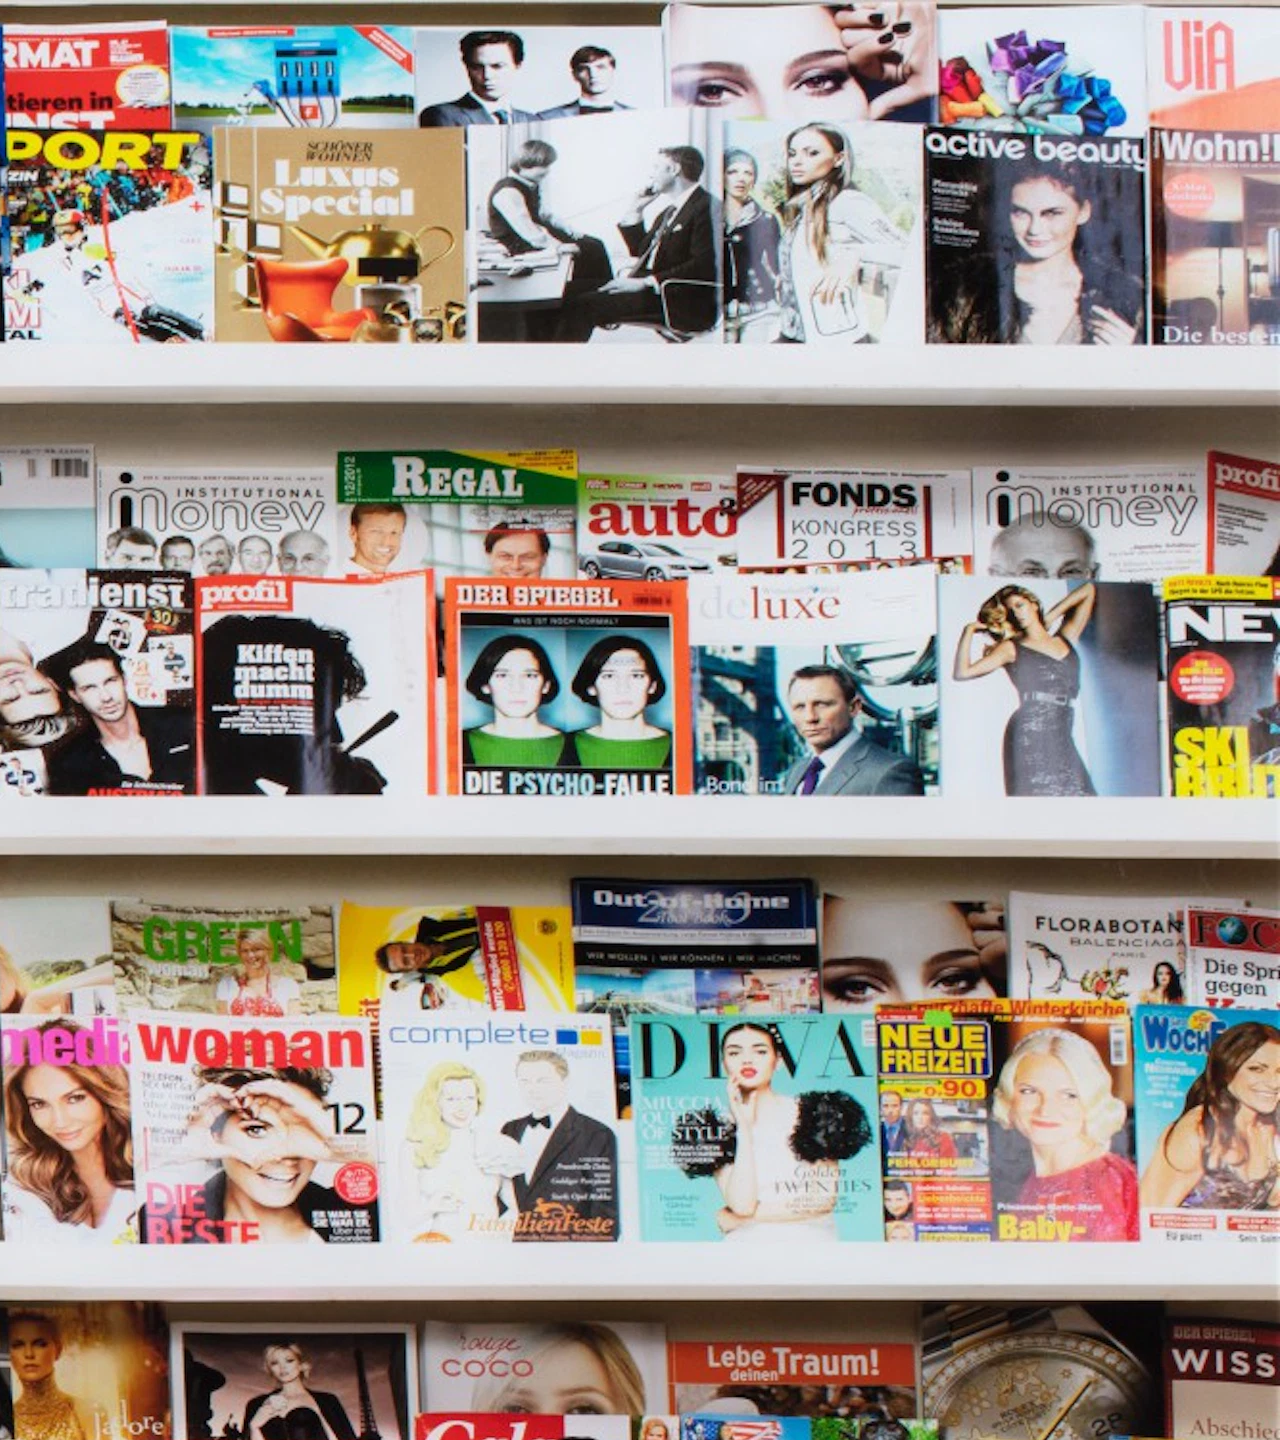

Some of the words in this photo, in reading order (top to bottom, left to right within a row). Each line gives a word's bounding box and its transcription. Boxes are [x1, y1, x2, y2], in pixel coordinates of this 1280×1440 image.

[927, 134, 1026, 161] active
[1036, 136, 1146, 171] beauty
[275, 162, 401, 189] Luxus
[260, 189, 416, 219] Special
[392, 457, 525, 498] REGAL
[177, 489, 325, 499] INSTITUTIONAL
[791, 483, 917, 507] FONDS
[791, 521, 919, 537] KONGRESS
[202, 581, 288, 604] profil
[457, 587, 507, 607] DER
[514, 587, 619, 607] SPIEGEL
[700, 587, 842, 622] deluxe
[238, 647, 315, 664] Kiffen
[235, 665, 315, 683] macht
[235, 684, 315, 701] dumm
[1174, 727, 1250, 766] SKI
[466, 774, 503, 795] DIE
[510, 774, 670, 795] PSYCHO-FALLE
[1204, 979, 1267, 997] gegen
[1009, 1000, 1125, 1016] Winterküche
[137, 1022, 365, 1067] woman
[390, 1022, 550, 1048] complete
[882, 1023, 987, 1049] NEUE
[882, 1051, 988, 1073] FREIZEIT
[329, 1103, 367, 1134] 12
[999, 1217, 1087, 1241] Baby-
[441, 1360, 534, 1378] COCO
[708, 1347, 765, 1367] Lebe
[774, 1348, 880, 1377] Traum!
[731, 1368, 778, 1382] deinen
